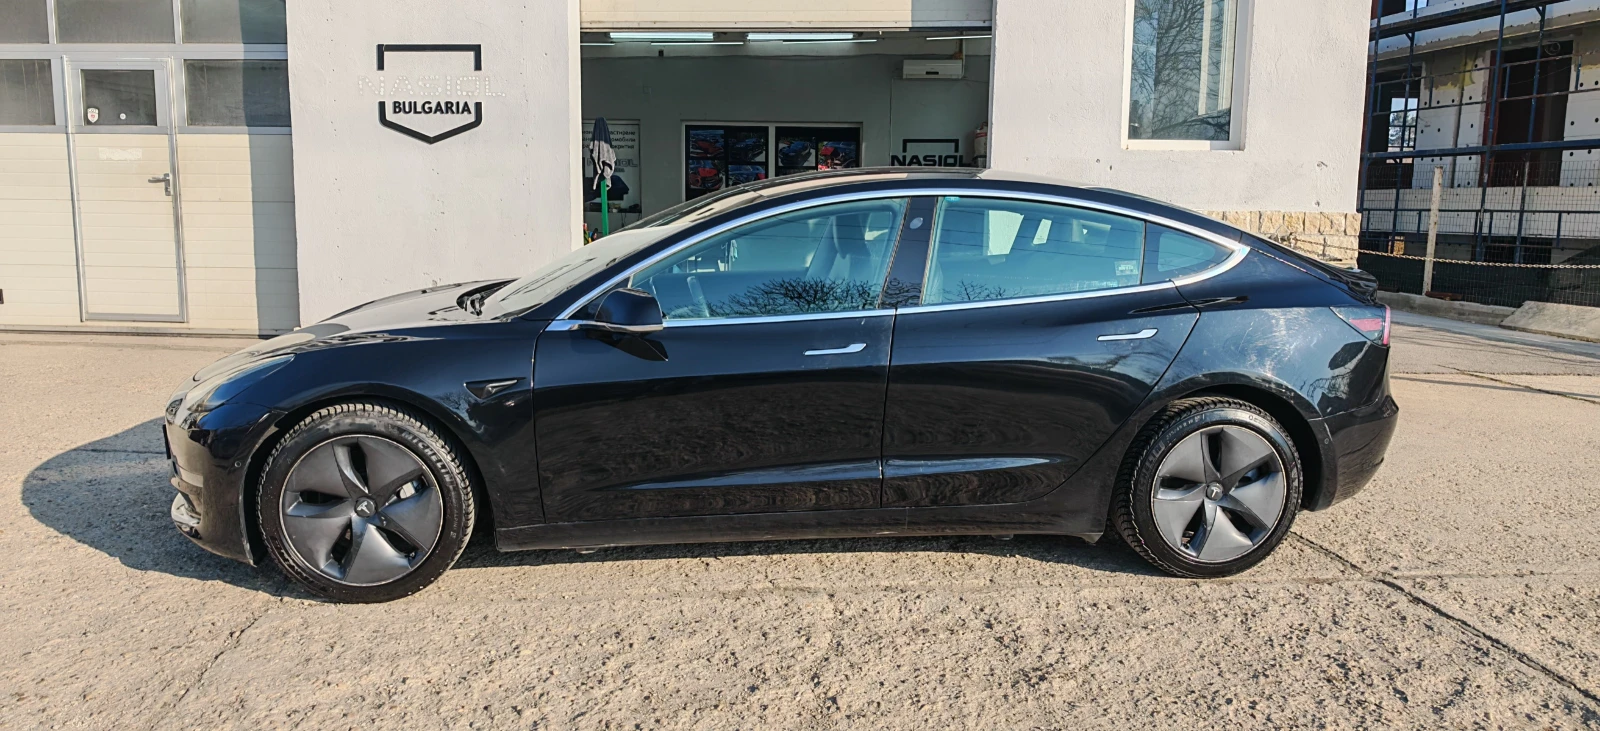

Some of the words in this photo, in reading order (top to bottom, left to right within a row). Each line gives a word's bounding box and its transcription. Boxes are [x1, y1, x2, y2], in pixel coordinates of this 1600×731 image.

[358, 76, 506, 96] NASIOL
[392, 100, 472, 114] BULGARIA
[891, 155, 971, 167] NASIOL
[402, 430, 455, 482] MICHELIN
